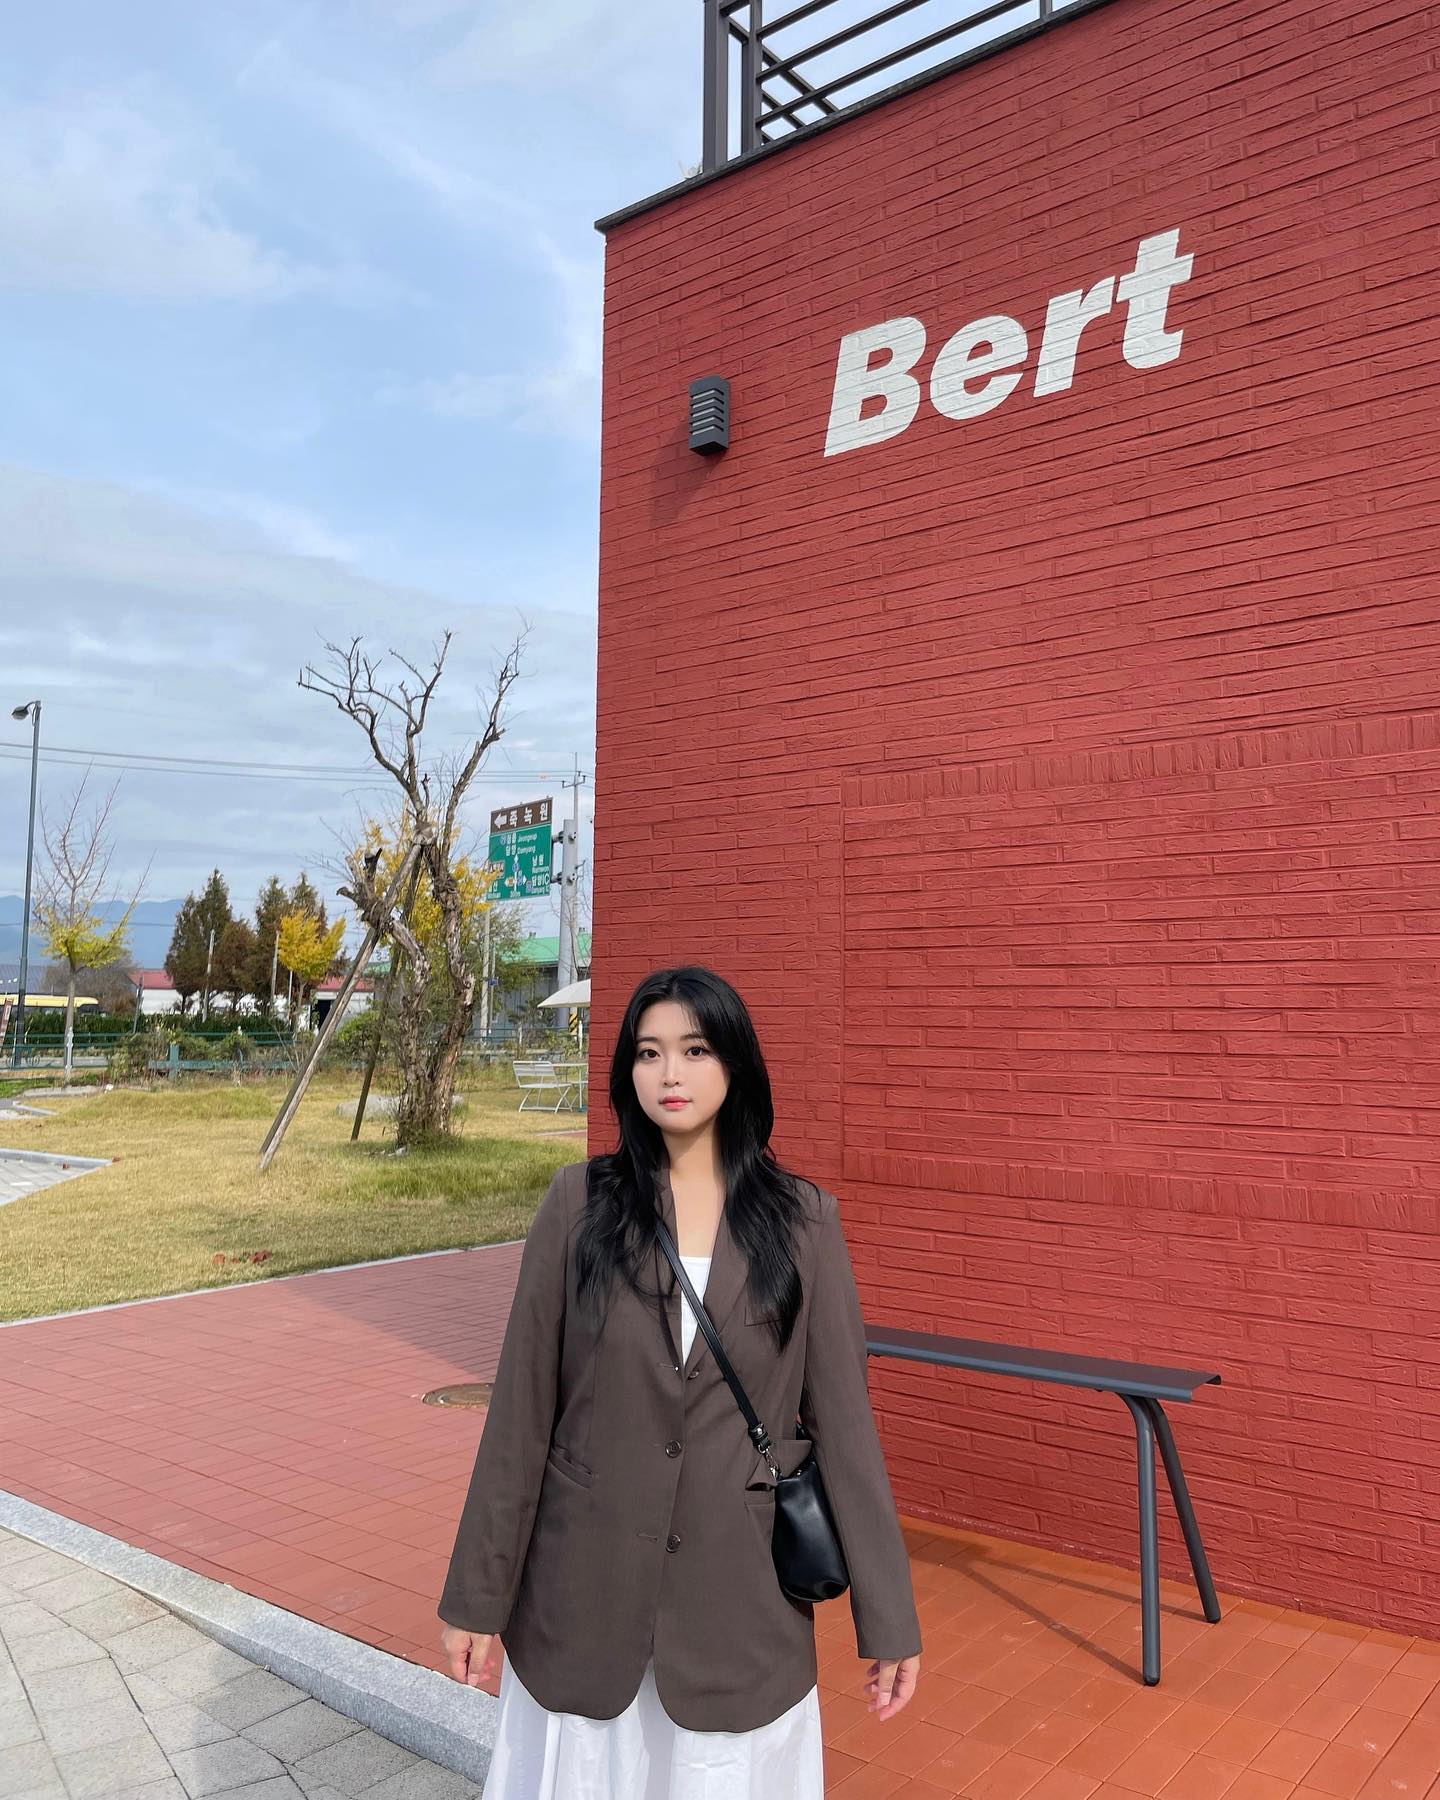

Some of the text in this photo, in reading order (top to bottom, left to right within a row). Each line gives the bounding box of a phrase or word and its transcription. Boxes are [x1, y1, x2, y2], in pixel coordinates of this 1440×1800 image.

[824, 228, 1194, 457] Bert
[510, 803, 548, 827] 죽녹원
[506, 844, 516, 856] 담양
